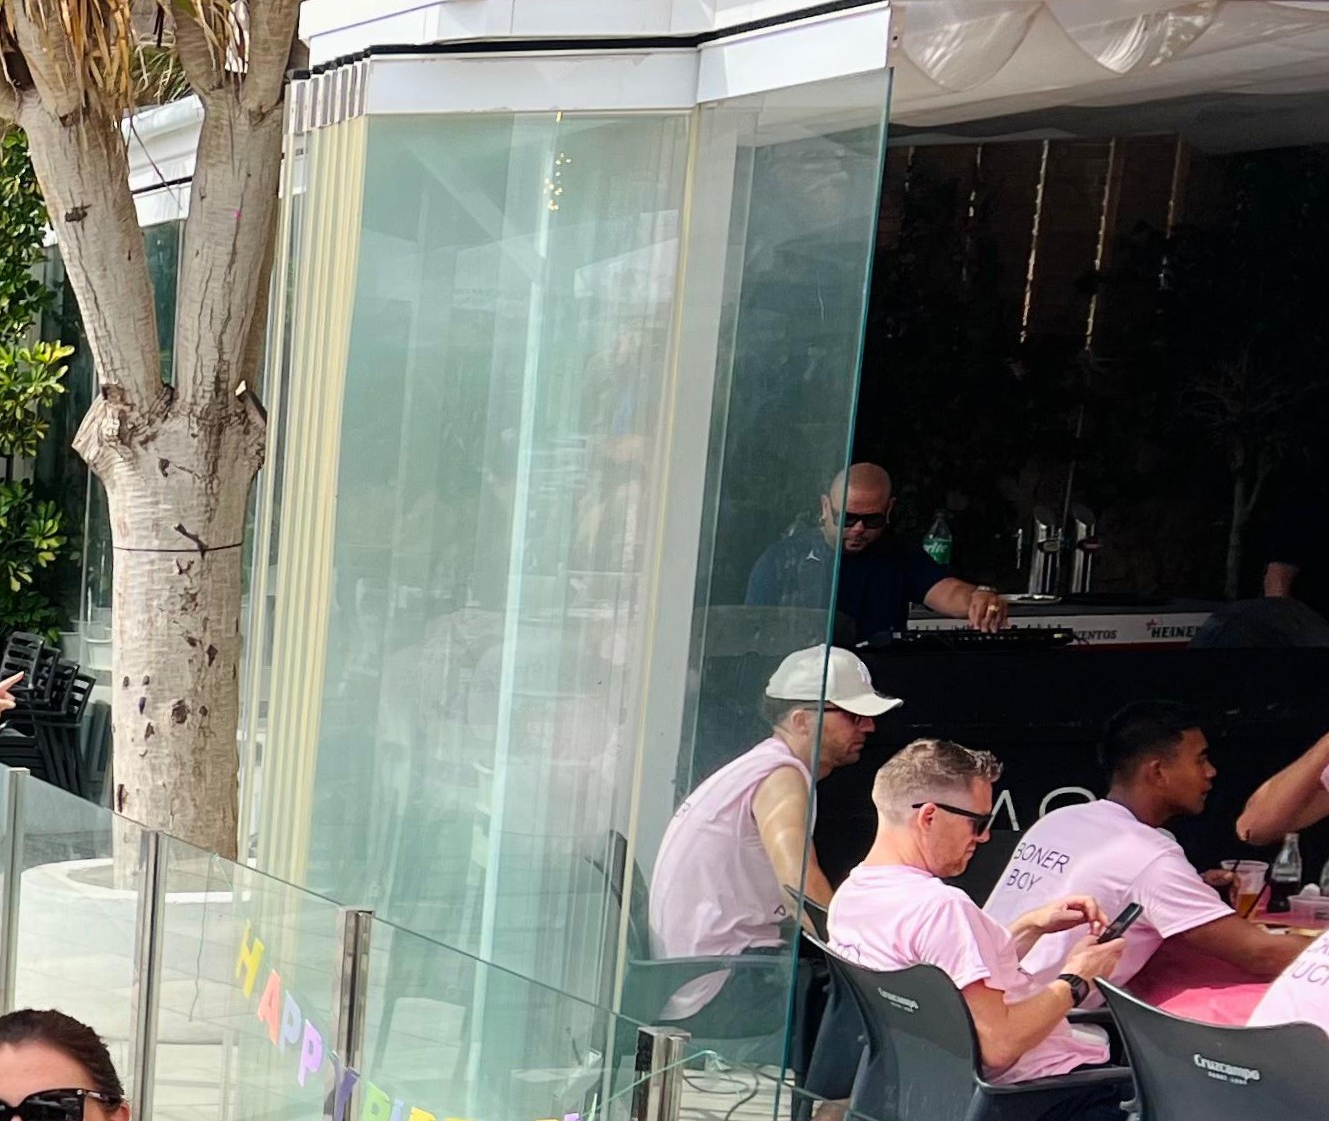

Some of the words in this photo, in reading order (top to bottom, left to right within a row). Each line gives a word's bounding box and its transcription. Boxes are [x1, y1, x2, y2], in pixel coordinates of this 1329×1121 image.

[1072, 629, 1118, 641] VENTOS
[1150, 625, 1198, 639] HEINE
[1012, 842, 1071, 874] BONER
[1006, 868, 1043, 891] BOY
[1193, 1053, 1261, 1082] Cruzcampo
